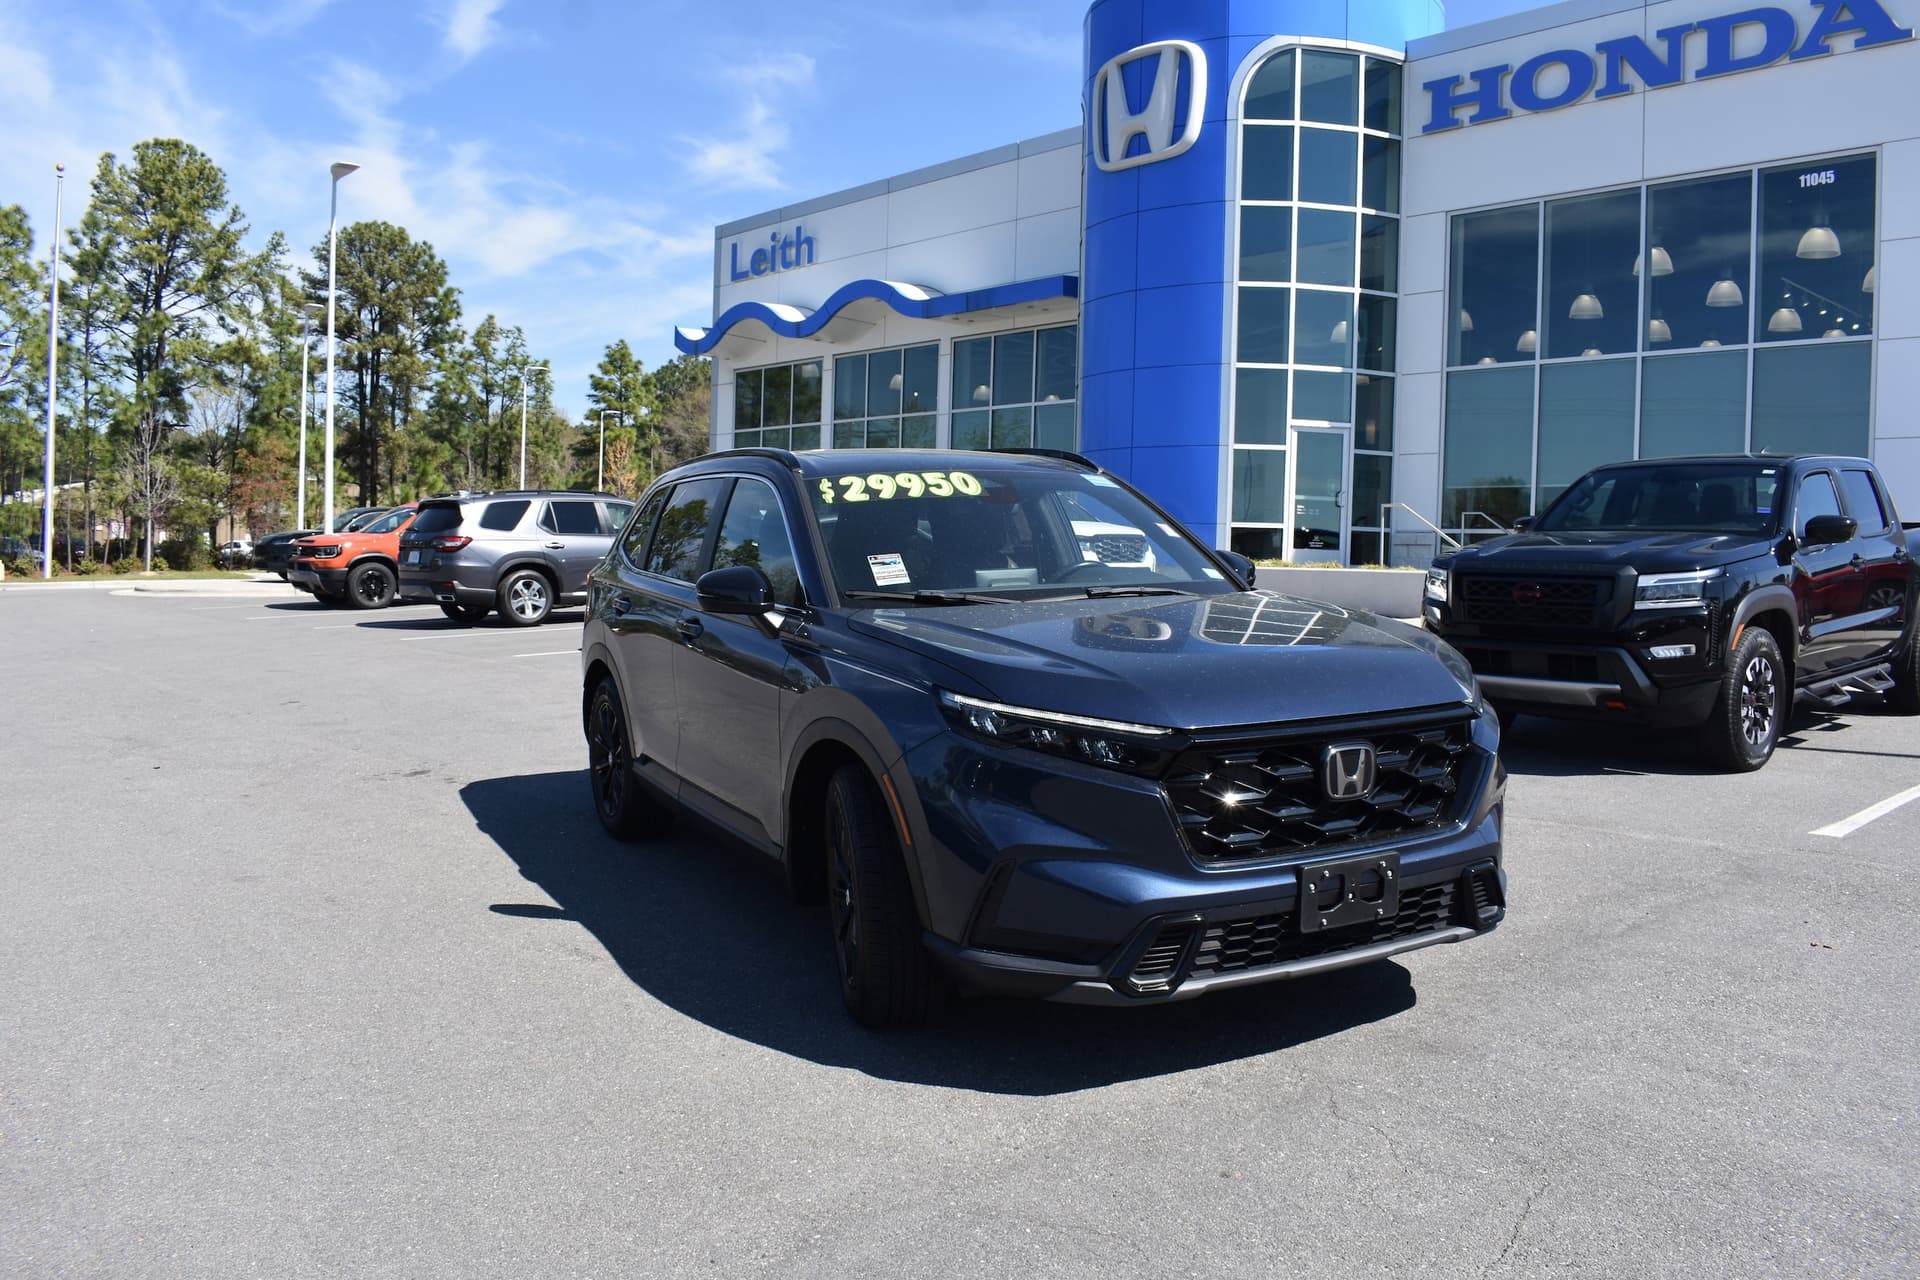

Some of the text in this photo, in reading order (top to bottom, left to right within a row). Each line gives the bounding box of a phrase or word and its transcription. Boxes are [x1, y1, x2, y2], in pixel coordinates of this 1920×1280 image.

[1422, 0, 1915, 133] HONDA
[1799, 170, 1835, 188] 11045
[730, 225, 814, 282] Leith
[819, 471, 982, 504] $29950
